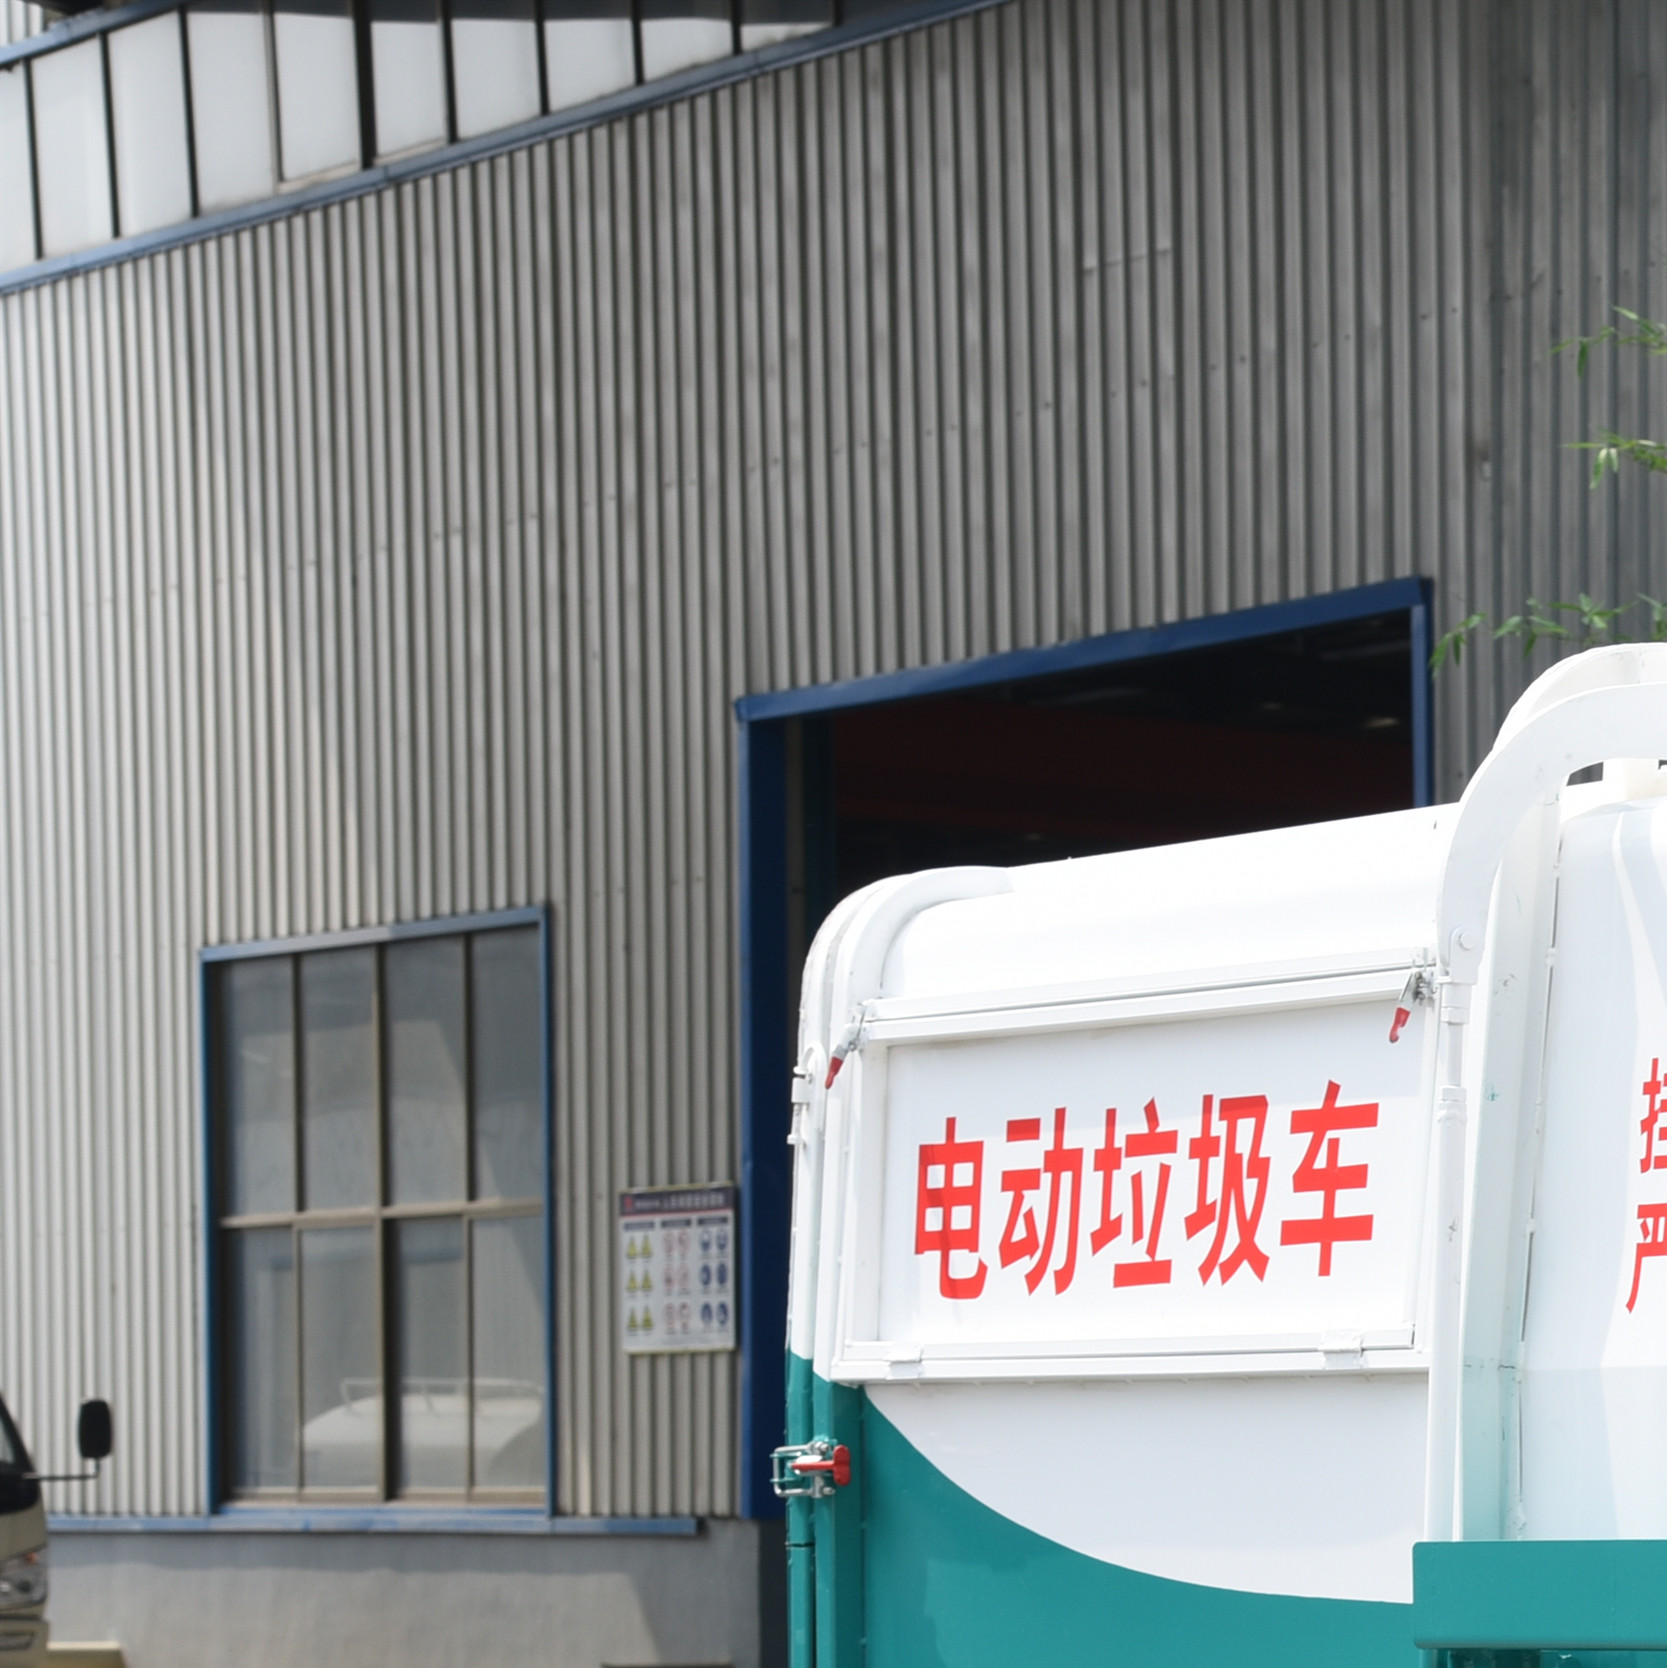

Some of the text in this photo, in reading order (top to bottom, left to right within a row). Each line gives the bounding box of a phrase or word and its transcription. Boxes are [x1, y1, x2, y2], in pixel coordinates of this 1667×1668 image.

[914, 1079, 1379, 1300] 电动垃圾车
